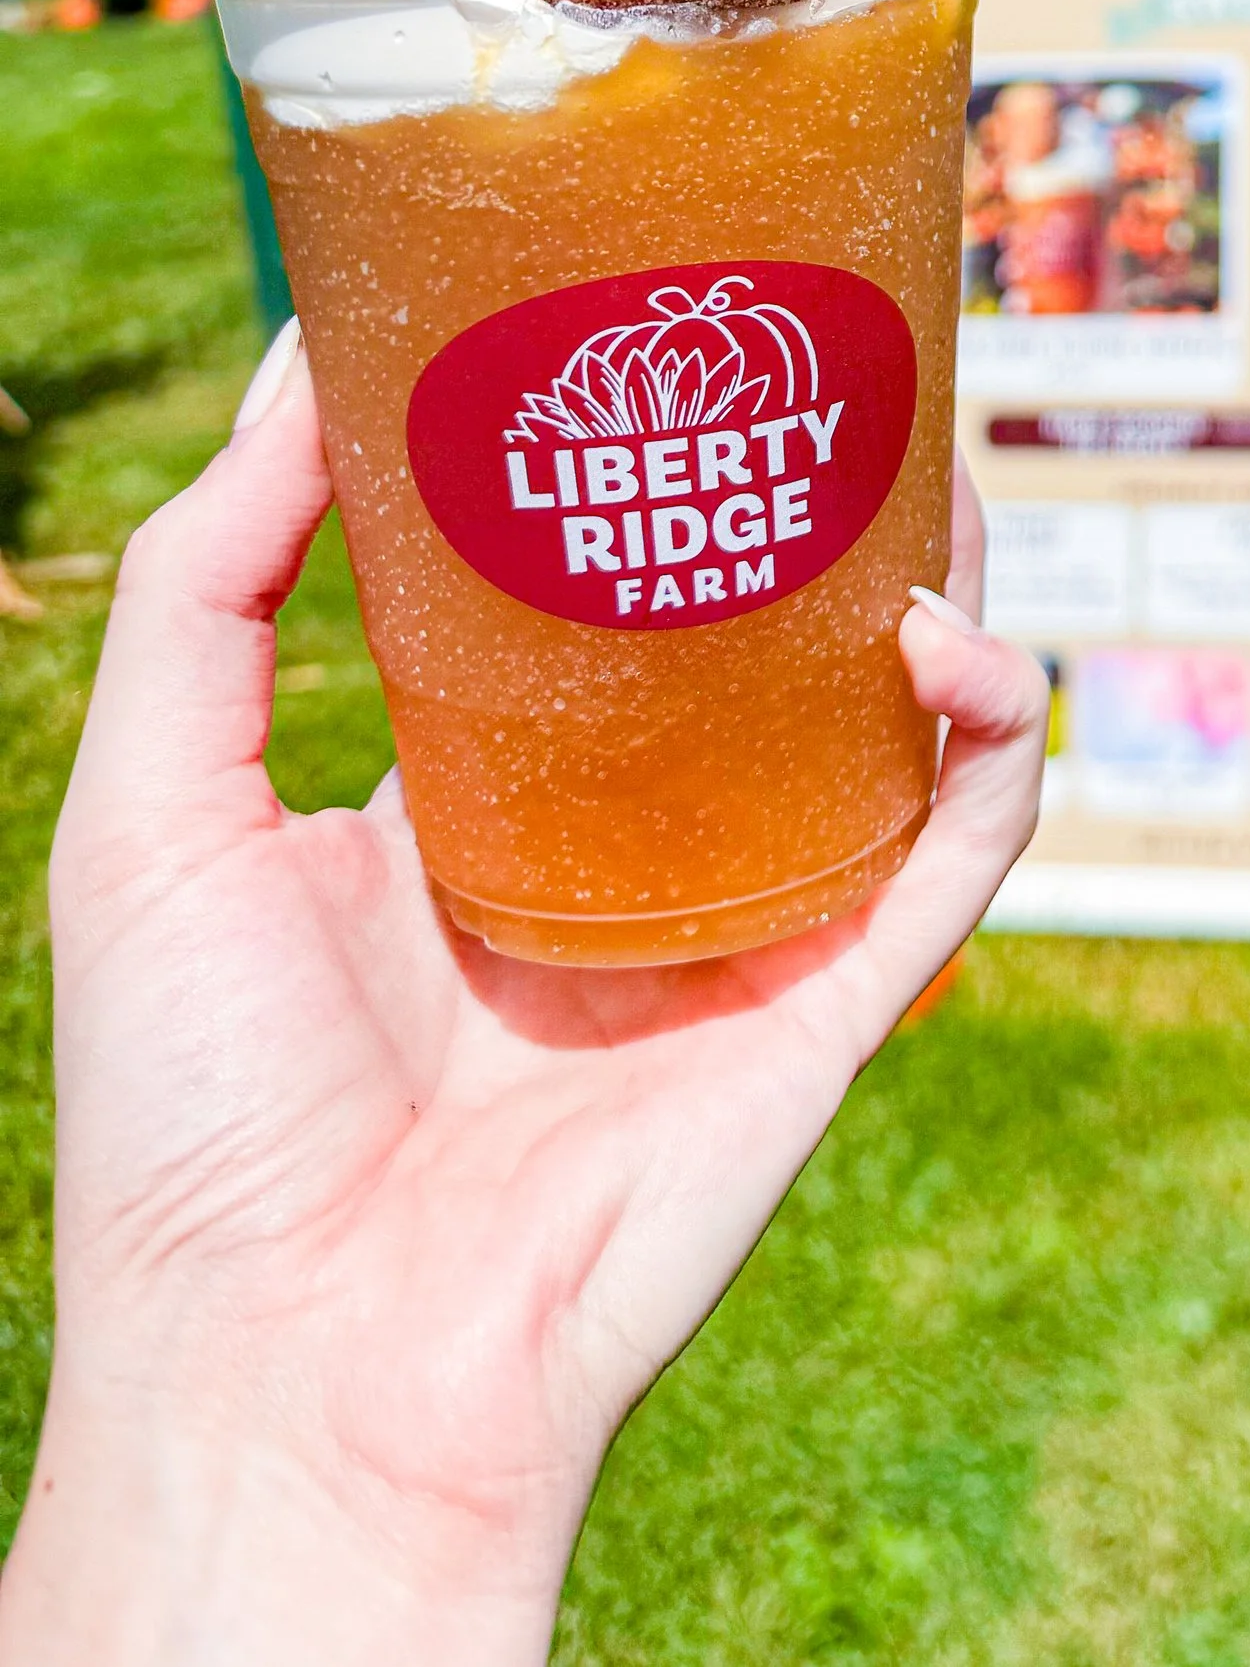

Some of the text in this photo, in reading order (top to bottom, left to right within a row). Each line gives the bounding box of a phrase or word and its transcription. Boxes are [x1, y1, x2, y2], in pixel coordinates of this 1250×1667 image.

[505, 401, 845, 510] LIBERTY
[562, 478, 813, 574] RIDGE
[614, 554, 776, 616] FARM
